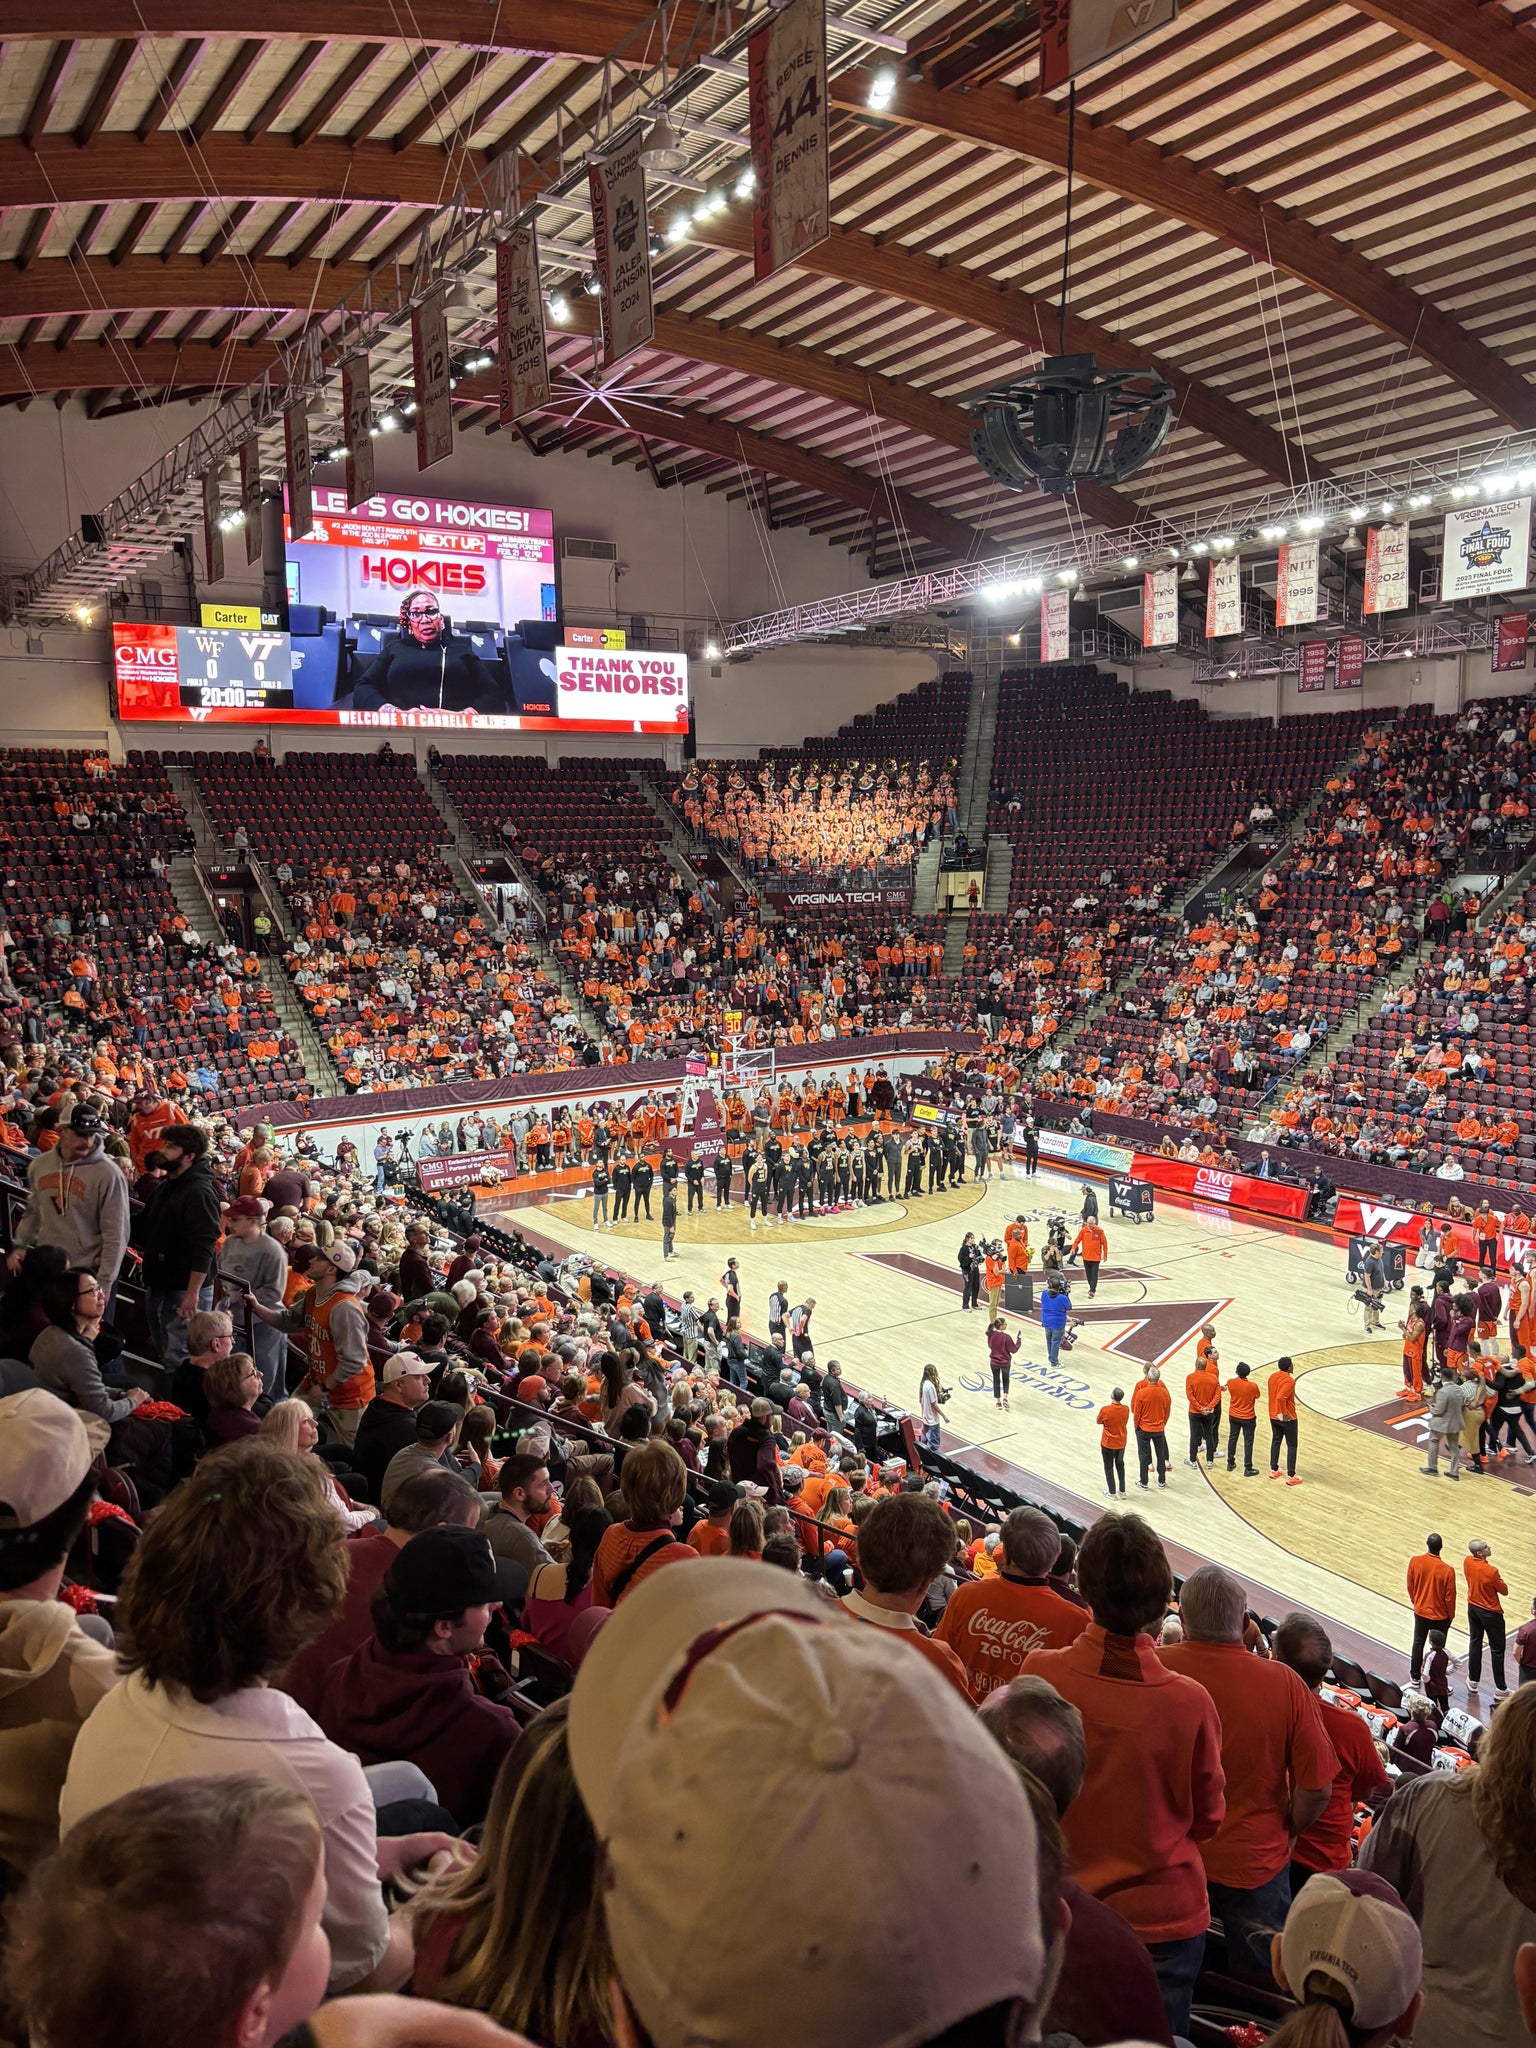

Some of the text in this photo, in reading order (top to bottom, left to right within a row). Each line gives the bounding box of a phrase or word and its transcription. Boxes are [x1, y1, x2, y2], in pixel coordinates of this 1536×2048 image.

[776, 49, 814, 89] RENEE
[773, 75, 821, 140] 44
[775, 133, 818, 175] DENNIS
[615, 253, 642, 281] CALEB
[613, 263, 646, 298] HENSON
[427, 351, 443, 384] 12
[517, 355, 541, 376] 2019
[392, 499, 430, 522] GO
[435, 503, 529, 531] HOKIES!
[1454, 500, 1521, 521] VIRGINIA TECH
[418, 533, 484, 550] NEXT UP:
[1461, 539, 1485, 556] FINAL
[1486, 536, 1511, 550] FOUR
[361, 554, 486, 591] HOKIES
[1290, 560, 1316, 573] NIT
[1472, 571, 1492, 580] FINAL
[1493, 567, 1512, 576] FOUR
[1215, 574, 1236, 586] NT
[1377, 571, 1406, 583] 2022
[1288, 586, 1314, 598] 1995
[214, 611, 280, 625] Carter CAT
[1155, 611, 1175, 621] 1979
[572, 633, 594, 642] Carter
[1492, 618, 1500, 669] WRESTLING
[1501, 636, 1525, 646] 1993
[115, 646, 177, 665] CMG
[238, 638, 285, 660] VT
[1342, 653, 1362, 661] 1962
[206, 659, 218, 679] 0
[253, 661, 265, 681] 0
[567, 656, 675, 675] THANK YOU
[1342, 662, 1362, 670] 1963
[559, 671, 684, 696] SENIORS!
[1305, 674, 1324, 682] 1960
[201, 687, 245, 707] 20:00
[188, 707, 213, 720] VT
[523, 703, 550, 712] HOKIES
[338, 711, 397, 725] WELCOME
[400, 712, 415, 726] TO
[419, 713, 469, 727] CASSELL
[788, 892, 882, 905] VIRGINIA TECH
[724, 1011, 742, 1021] 20:00
[726, 1020, 741, 1033] 30
[919, 1108, 933, 1117] Carter
[694, 1139, 725, 1150] DELTA
[421, 1152, 509, 1171] CMG Exclusive Student Housing
[449, 1164, 467, 1172] Partner
[430, 1177, 454, 1188] LET'S
[454, 1175, 470, 1184] GO
[1197, 1168, 1234, 1188] CMG
[1114, 1182, 1132, 1196] VT
[1360, 1202, 1414, 1239] VT
[967, 1608, 1053, 1652] Coca-Cola
[980, 1641, 1022, 1665] zero
[1309, 1951, 1360, 1981] VIRGINIA TECH
